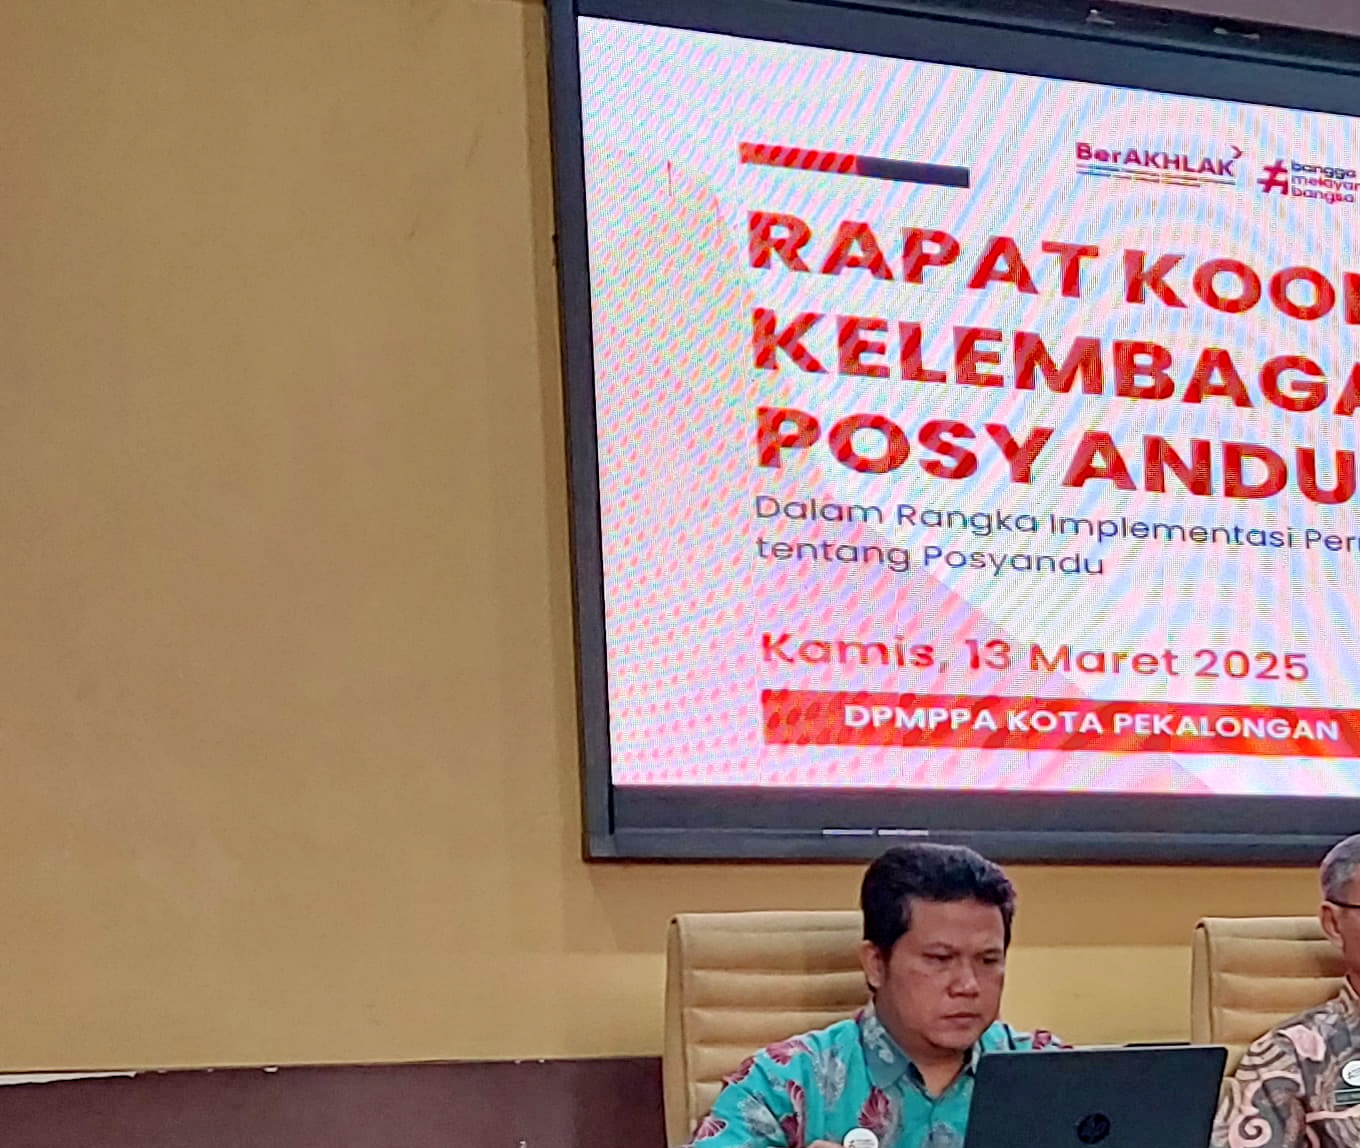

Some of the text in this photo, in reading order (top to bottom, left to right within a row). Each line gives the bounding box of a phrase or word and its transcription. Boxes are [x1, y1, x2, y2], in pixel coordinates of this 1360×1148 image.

[1076, 142, 1235, 177] BerAKHLAK
[748, 210, 1099, 300] RAPAT
[757, 406, 1357, 504] POSYANDU
[756, 494, 883, 526] Dalam
[897, 504, 1037, 537] Rangka
[1049, 512, 1294, 550] Implementasi
[757, 536, 1105, 577] tentang Posyandu
[761, 632, 1310, 682] Kamis, 13 Maret 2025
[844, 705, 1339, 742] DPMPPA KOTA PEKALONGAN
